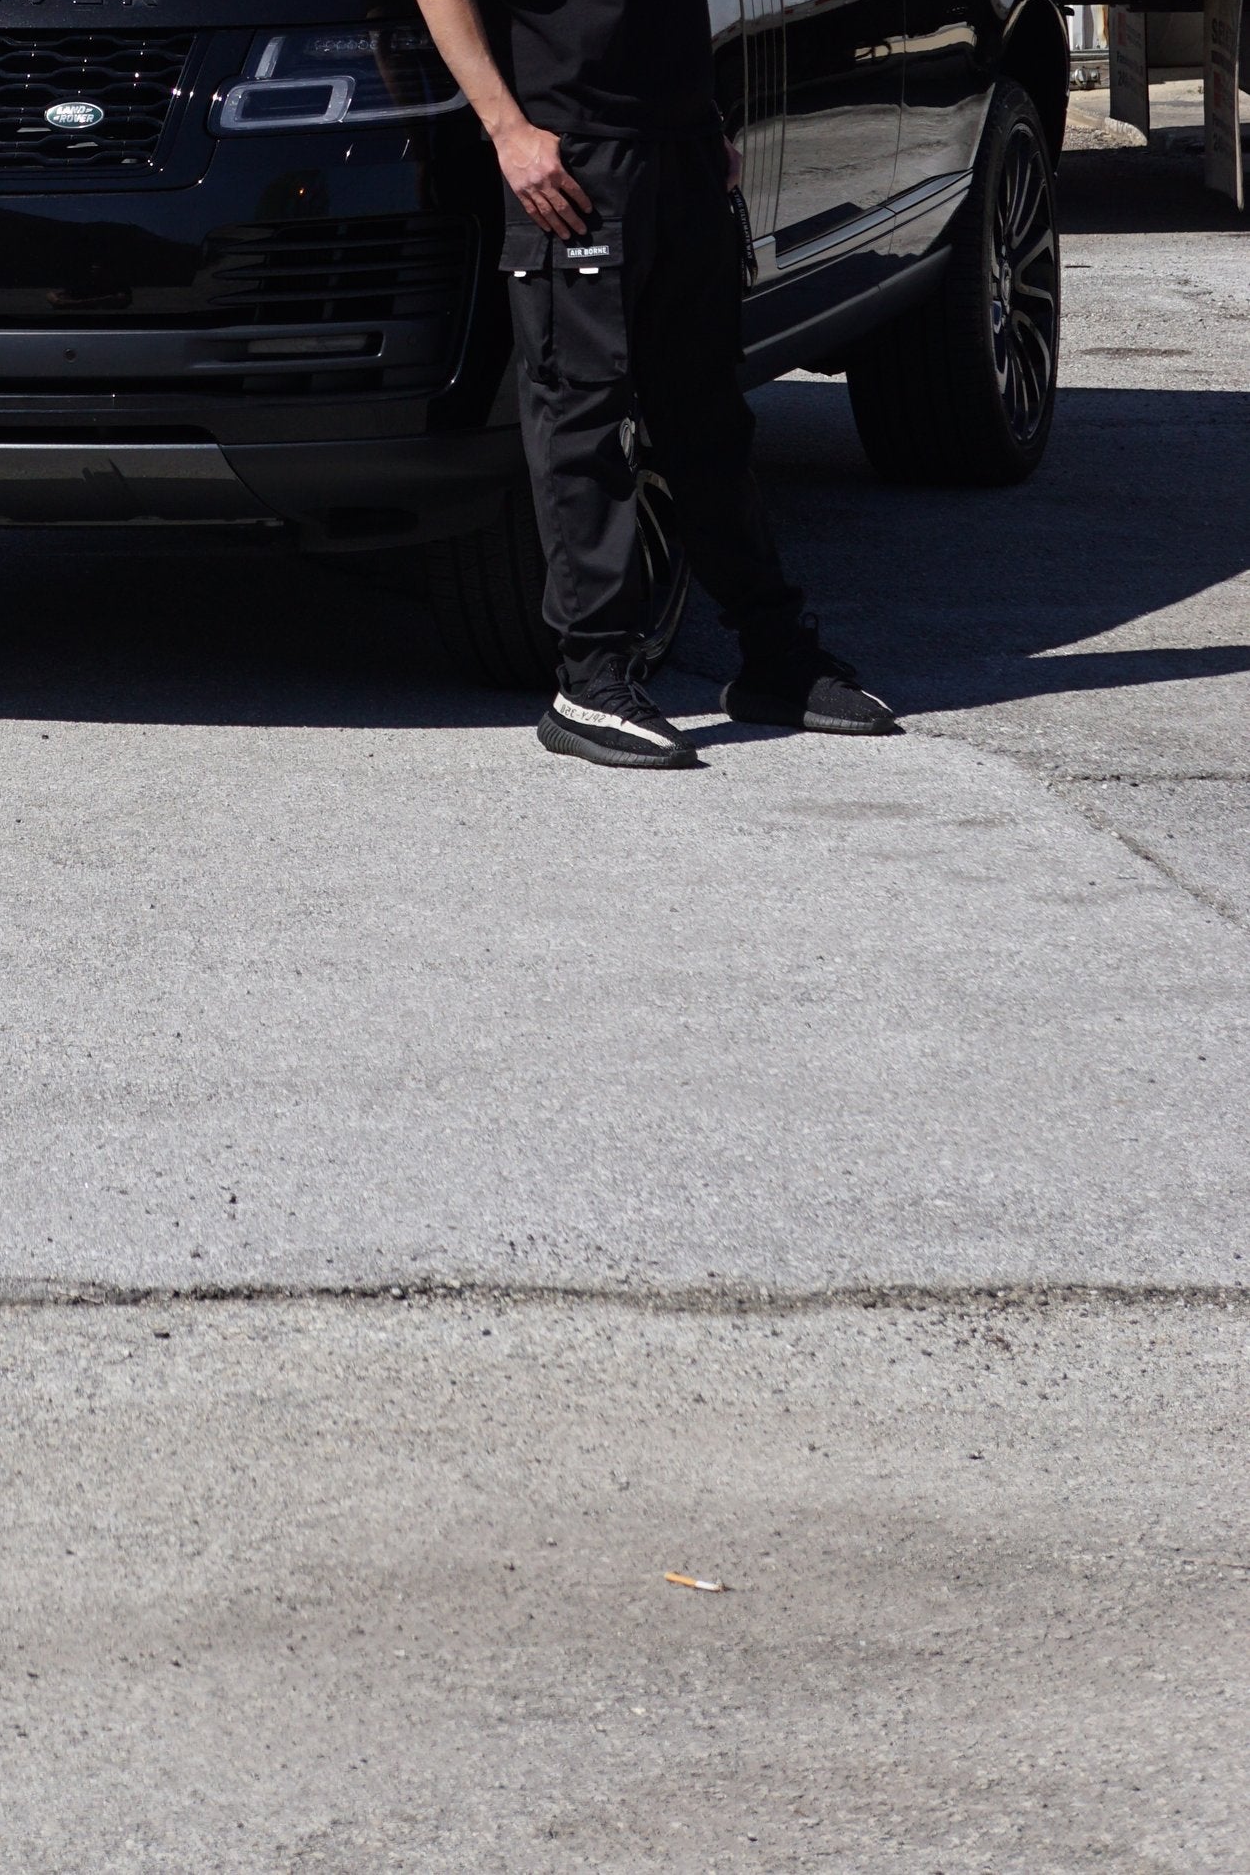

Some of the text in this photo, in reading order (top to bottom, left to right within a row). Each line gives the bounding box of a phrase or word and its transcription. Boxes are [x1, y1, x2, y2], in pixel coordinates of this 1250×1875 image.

[57, 106, 86, 114] LAND
[59, 114, 94, 123] ROVER
[570, 247, 608, 257] AIR BORNE
